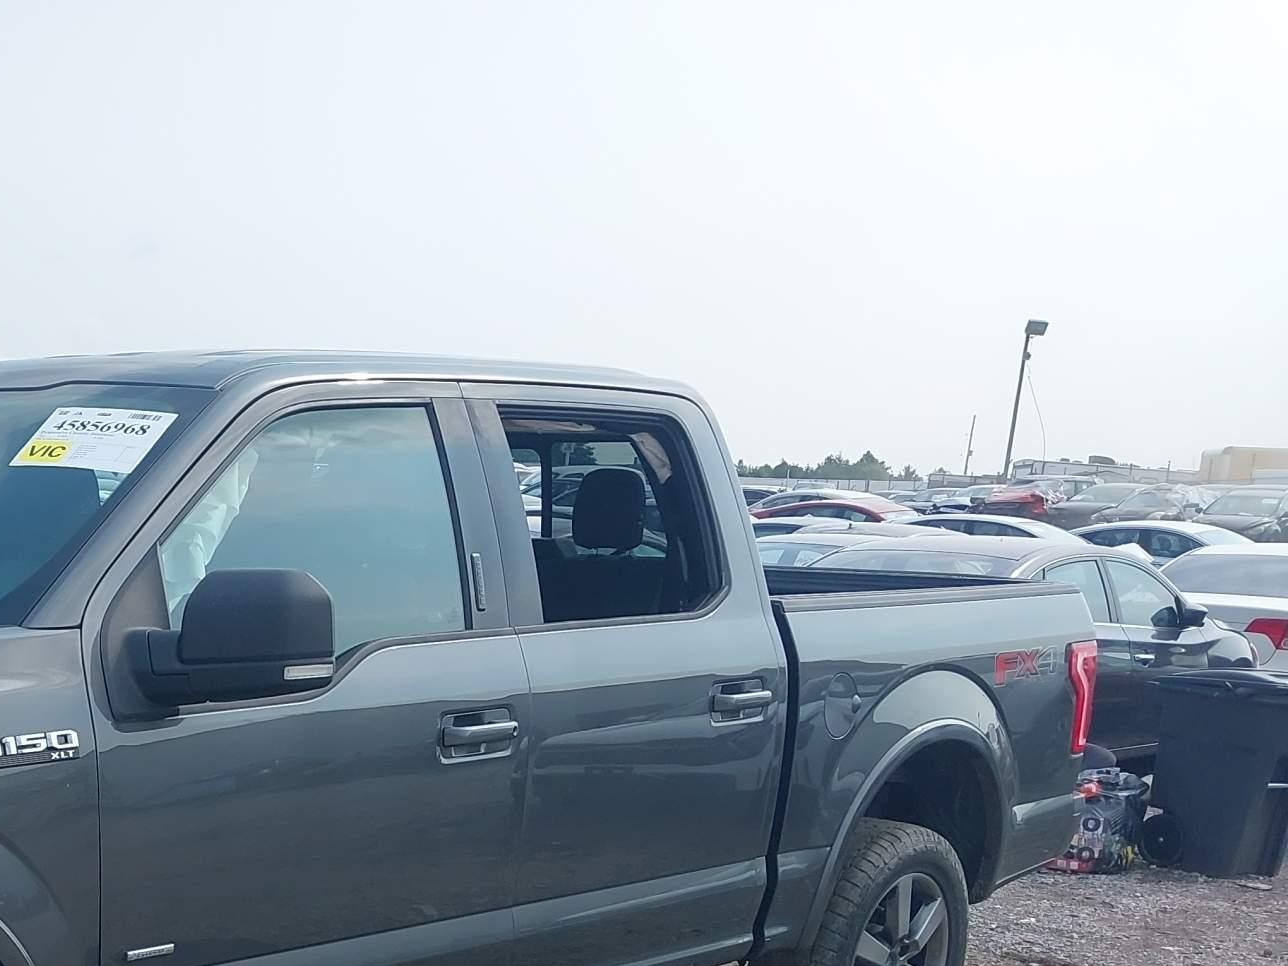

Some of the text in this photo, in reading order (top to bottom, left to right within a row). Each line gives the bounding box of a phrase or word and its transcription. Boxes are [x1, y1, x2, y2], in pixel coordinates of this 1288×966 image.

[53, 420, 151, 436] 45856968
[28, 445, 66, 458] VIC
[994, 645, 1056, 688] FX4
[50, 749, 75, 760] XLT
